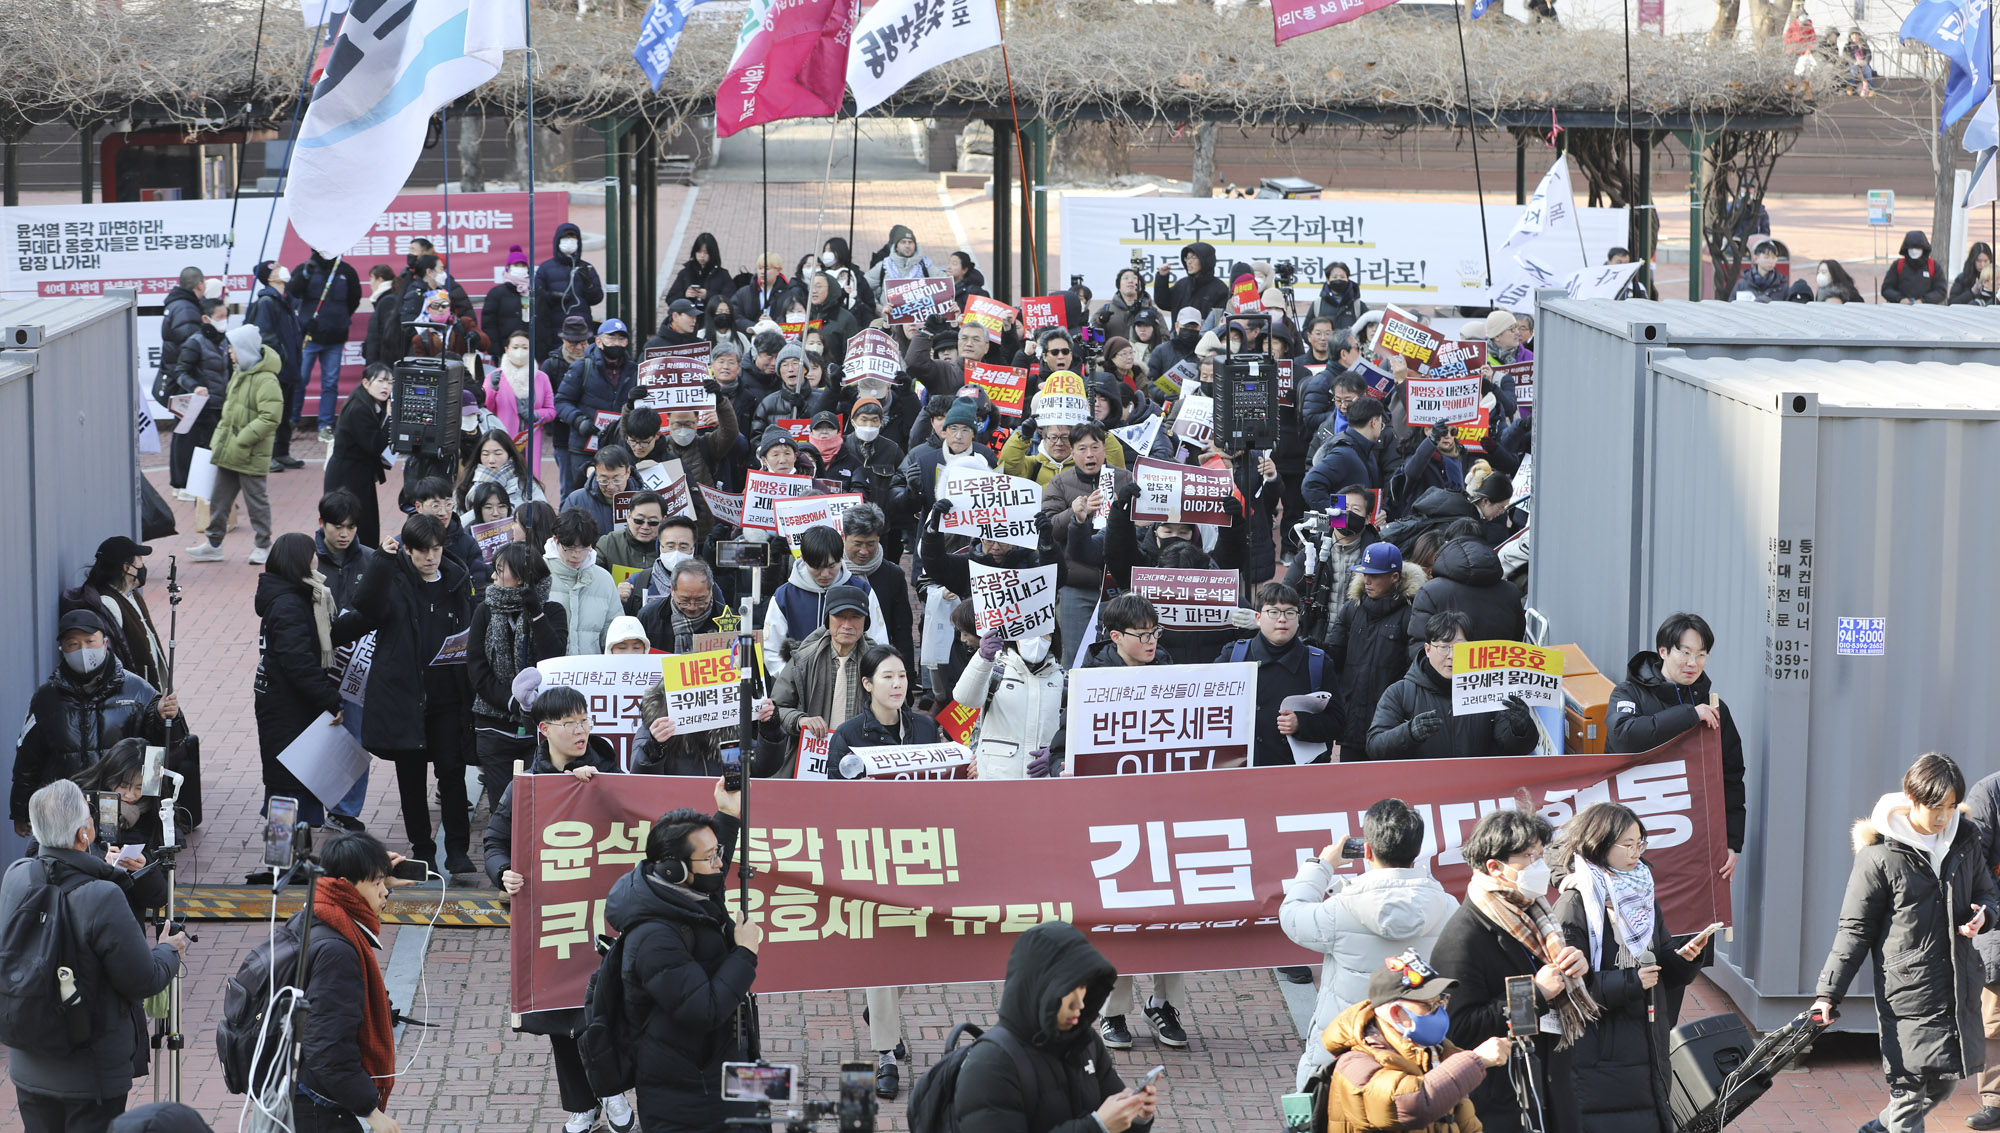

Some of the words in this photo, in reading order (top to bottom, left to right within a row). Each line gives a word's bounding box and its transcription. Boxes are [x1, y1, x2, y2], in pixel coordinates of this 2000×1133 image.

[16, 222, 61, 239] 윤석열
[64, 221, 95, 238] 즉각
[98, 219, 164, 237] 파면하라!
[436, 210, 514, 230] 지지하는
[1131, 213, 1236, 242] 내란수괴
[1249, 215, 1364, 245] 즉각파면!
[17, 238, 62, 255] 쿠데타
[65, 236, 140, 254] 옹호자들은
[394, 233, 490, 255] 응합니다
[18, 255, 48, 272] 당장
[51, 254, 101, 270] 나가라!
[43, 284, 66, 295] 40대
[69, 282, 100, 294] 사범대
[146, 278, 180, 292] 국어교
[891, 295, 936, 320] 민주주의
[1026, 303, 1051, 317] 윤석열
[1381, 332, 1433, 364] 민생회복
[676, 388, 709, 404] 파면!
[1410, 385, 1445, 398] 계엄옹호
[1446, 382, 1479, 397] 내란동조
[1415, 400, 1440, 411] 고대가
[1442, 397, 1475, 410] 막아내자
[749, 478, 787, 496] 계엄옹호
[947, 475, 1011, 496] 민주광장
[1143, 473, 1177, 483] 계엄규탄
[1147, 482, 1173, 493] 압도적
[1184, 472, 1231, 486] 계엄규탄
[971, 488, 1036, 510] 지켜내고
[1150, 493, 1169, 504] 가결
[1184, 484, 1231, 498] 총회정신
[942, 506, 1008, 529] 열사정신
[976, 519, 1040, 539] 계승하자
[970, 569, 1021, 595] 민주광장
[1136, 573, 1175, 582] 고려대학교
[1177, 575, 1208, 583] 학생들이
[1209, 576, 1236, 584] 말한다!
[1776, 539, 1792, 627] 임대전문
[1797, 539, 1813, 631] 둥지컨테이너
[982, 575, 1048, 610] 지켜내고
[1133, 585, 1189, 601] 내란수괴
[1194, 587, 1236, 602] 윤석열
[1185, 607, 1230, 623] 파면!
[1775, 640, 1809, 651] 031-
[1469, 645, 1547, 671] 내란옹호
[1775, 655, 1809, 666] 359-
[546, 671, 617, 686] 고려대학교
[679, 655, 741, 687] 내란옹
[1455, 671, 1504, 691] 극우세력
[1508, 670, 1558, 691] 물러가라
[1774, 668, 1809, 680] 9710
[670, 687, 719, 711] 극우세력
[1083, 685, 1147, 704] 고려대학교
[1150, 683, 1201, 700] 학생들이
[1203, 680, 1246, 697] 말한다!
[1461, 692, 1505, 707] 고려대학교
[676, 712, 719, 727] 고려대학교
[1092, 705, 1234, 747] 반민주세력
[871, 747, 965, 771] 반민주세력
[836, 826, 960, 886] 파면!
[1089, 817, 1256, 910] 긴급
